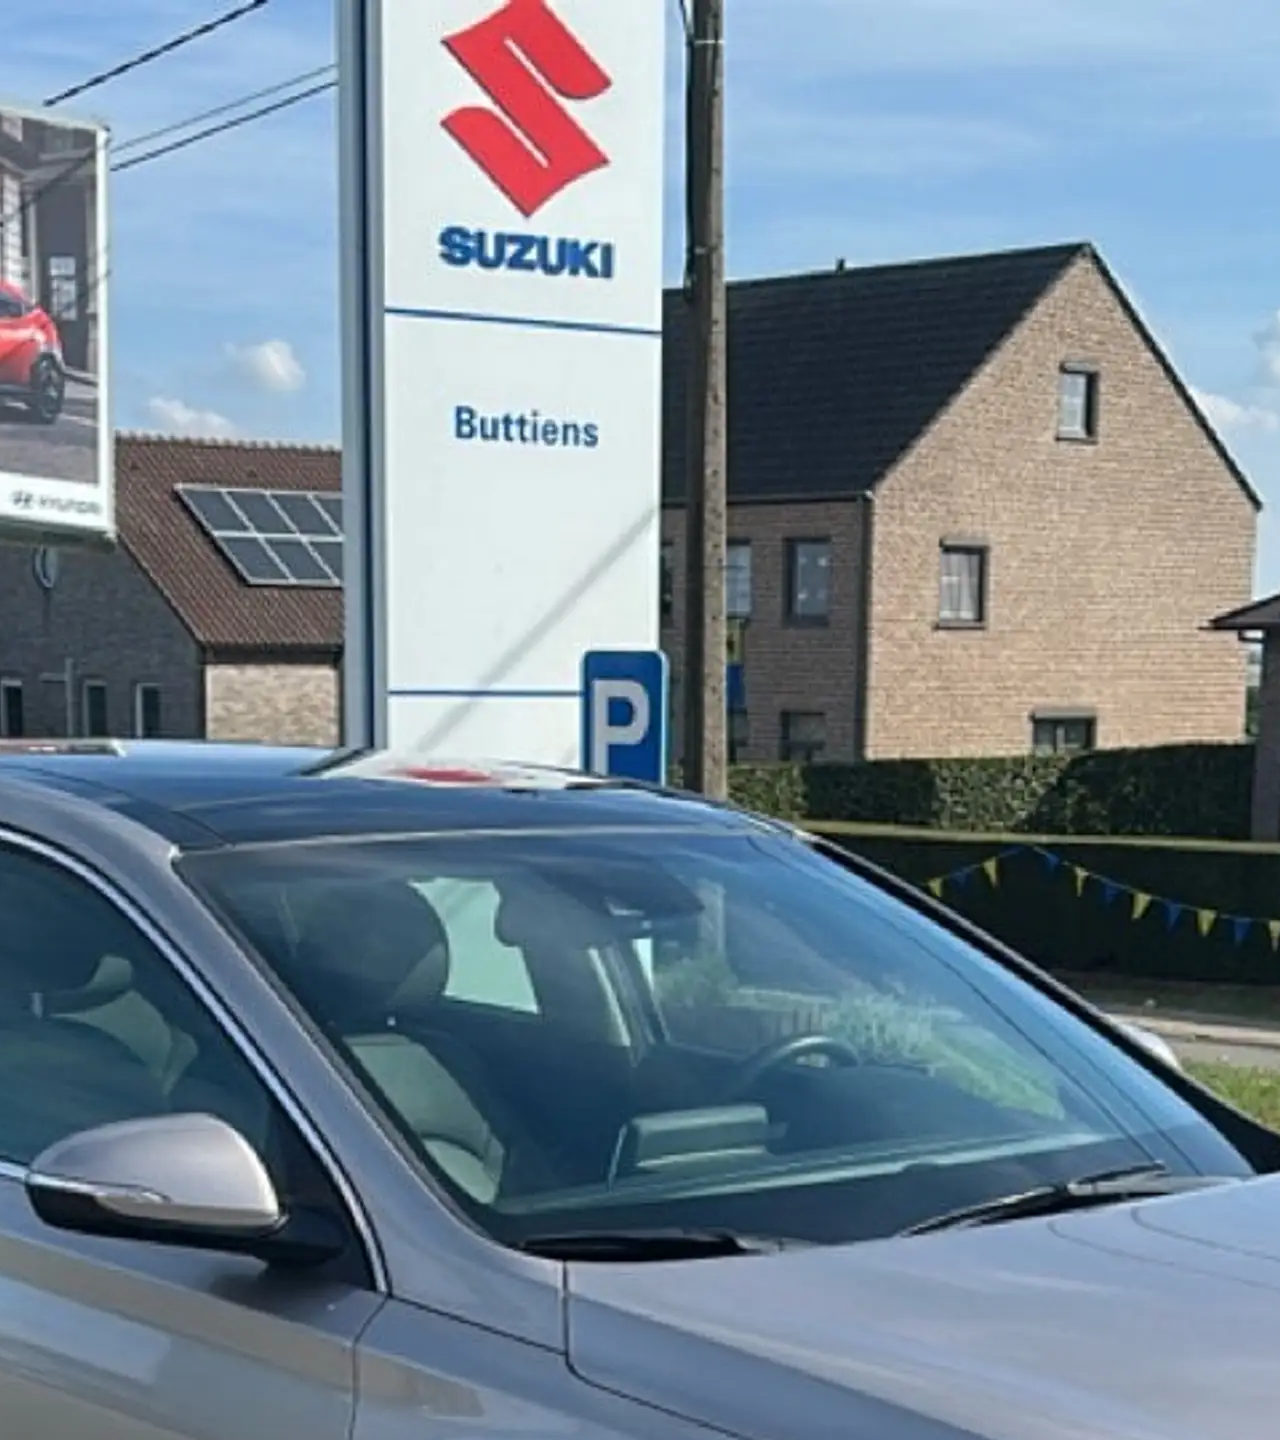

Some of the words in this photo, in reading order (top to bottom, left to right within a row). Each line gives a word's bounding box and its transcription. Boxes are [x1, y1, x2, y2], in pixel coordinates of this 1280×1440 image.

[438, 226, 614, 279] SUZUKI
[454, 405, 599, 448] Buttiens
[591, 678, 650, 776] P
